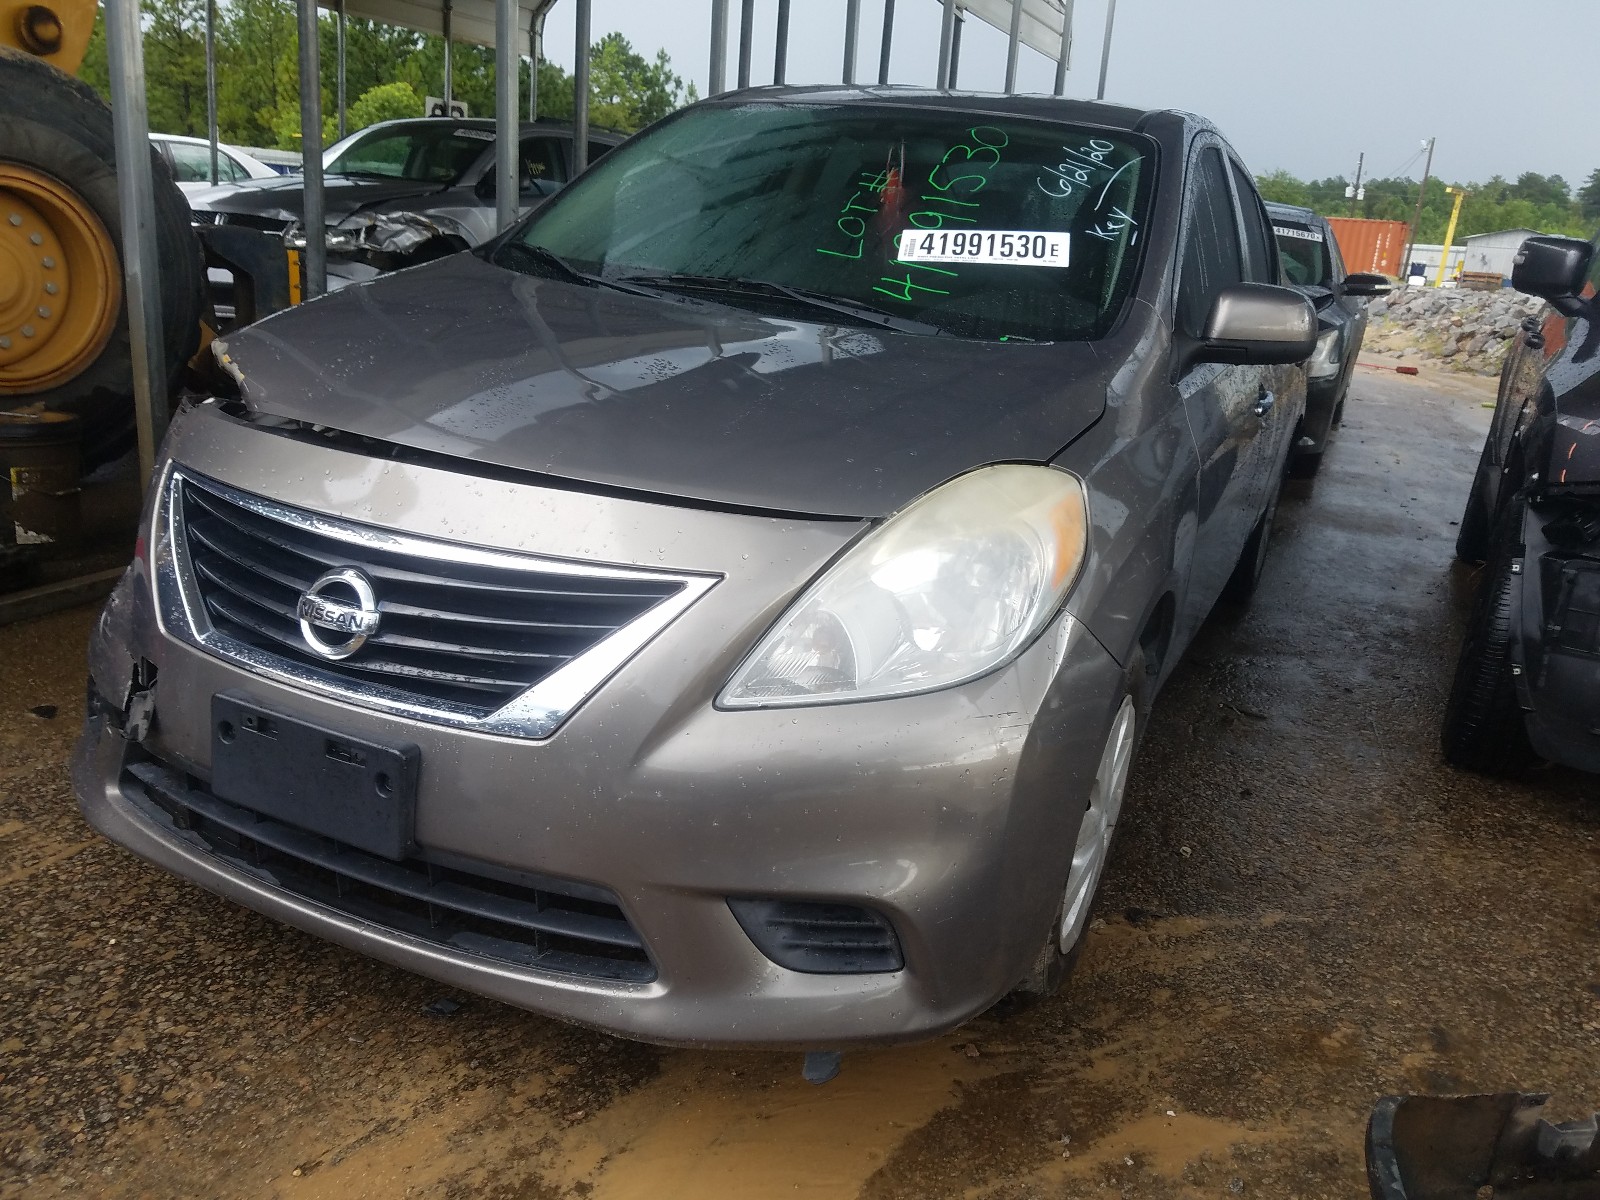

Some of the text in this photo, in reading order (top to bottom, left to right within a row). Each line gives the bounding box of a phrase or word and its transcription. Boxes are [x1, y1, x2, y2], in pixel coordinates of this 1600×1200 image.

[1037, 139, 1114, 197] 6/21/20
[872, 126, 1009, 301] 4191530
[919, 232, 1047, 259] 41991530
[1050, 243, 1059, 258] E
[302, 602, 364, 629] NISSAN
